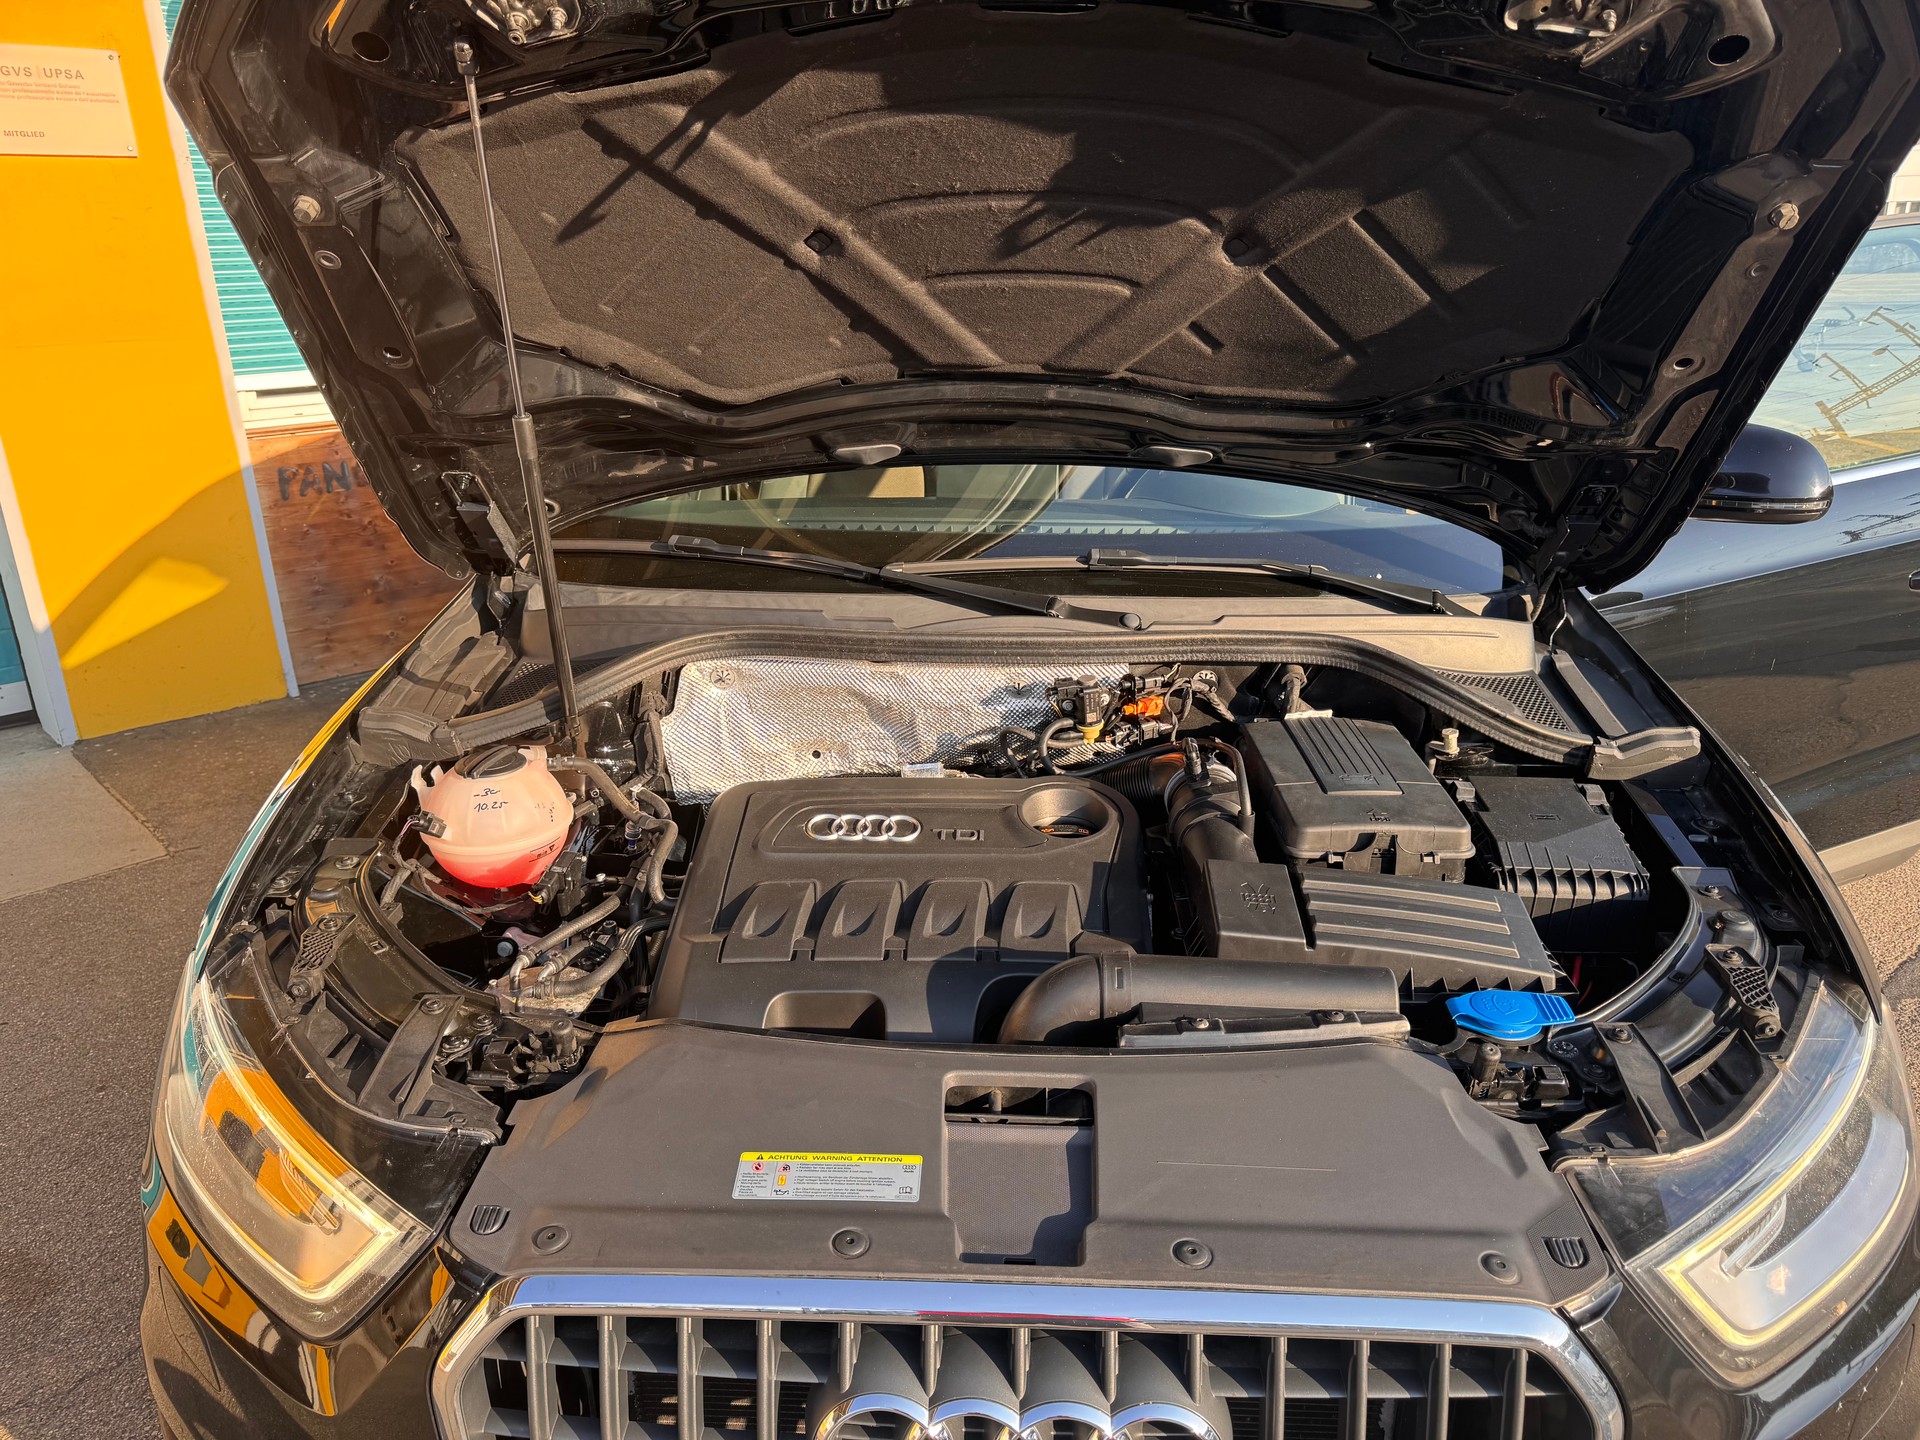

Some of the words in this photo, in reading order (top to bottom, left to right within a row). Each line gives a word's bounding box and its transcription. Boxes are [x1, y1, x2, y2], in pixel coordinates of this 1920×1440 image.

[0, 65, 32, 77] GVS
[43, 67, 85, 80] UPSA
[3, 130, 45, 138] MITGLIED
[932, 828, 985, 841] TDI
